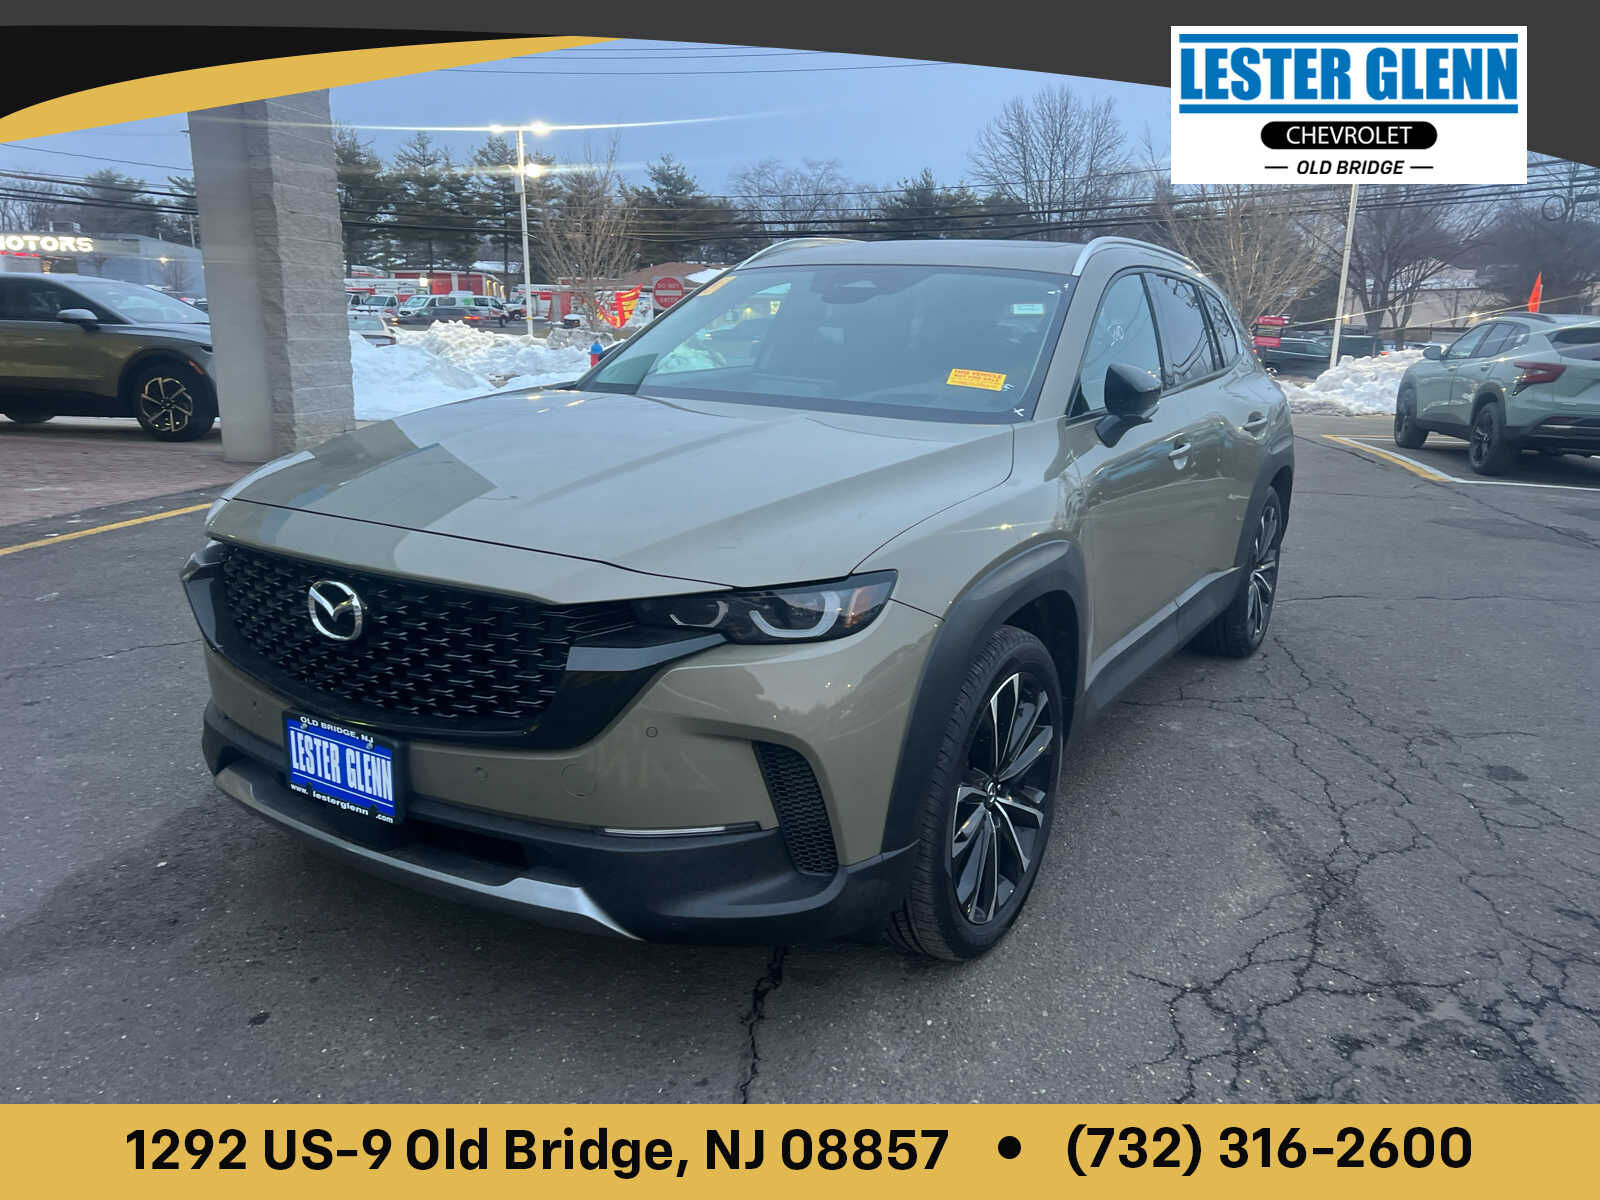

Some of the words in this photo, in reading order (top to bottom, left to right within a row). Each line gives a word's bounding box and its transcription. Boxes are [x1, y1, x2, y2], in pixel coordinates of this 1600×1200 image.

[300, 716, 319, 727] OLD
[320, 722, 360, 740] BRIDGE,
[361, 733, 374, 744] NJ
[289, 729, 342, 784] LESTER
[345, 747, 393, 801] GLENN
[290, 783, 309, 795] www.
[312, 790, 369, 815] lesterglenn
[375, 814, 394, 824] .com
